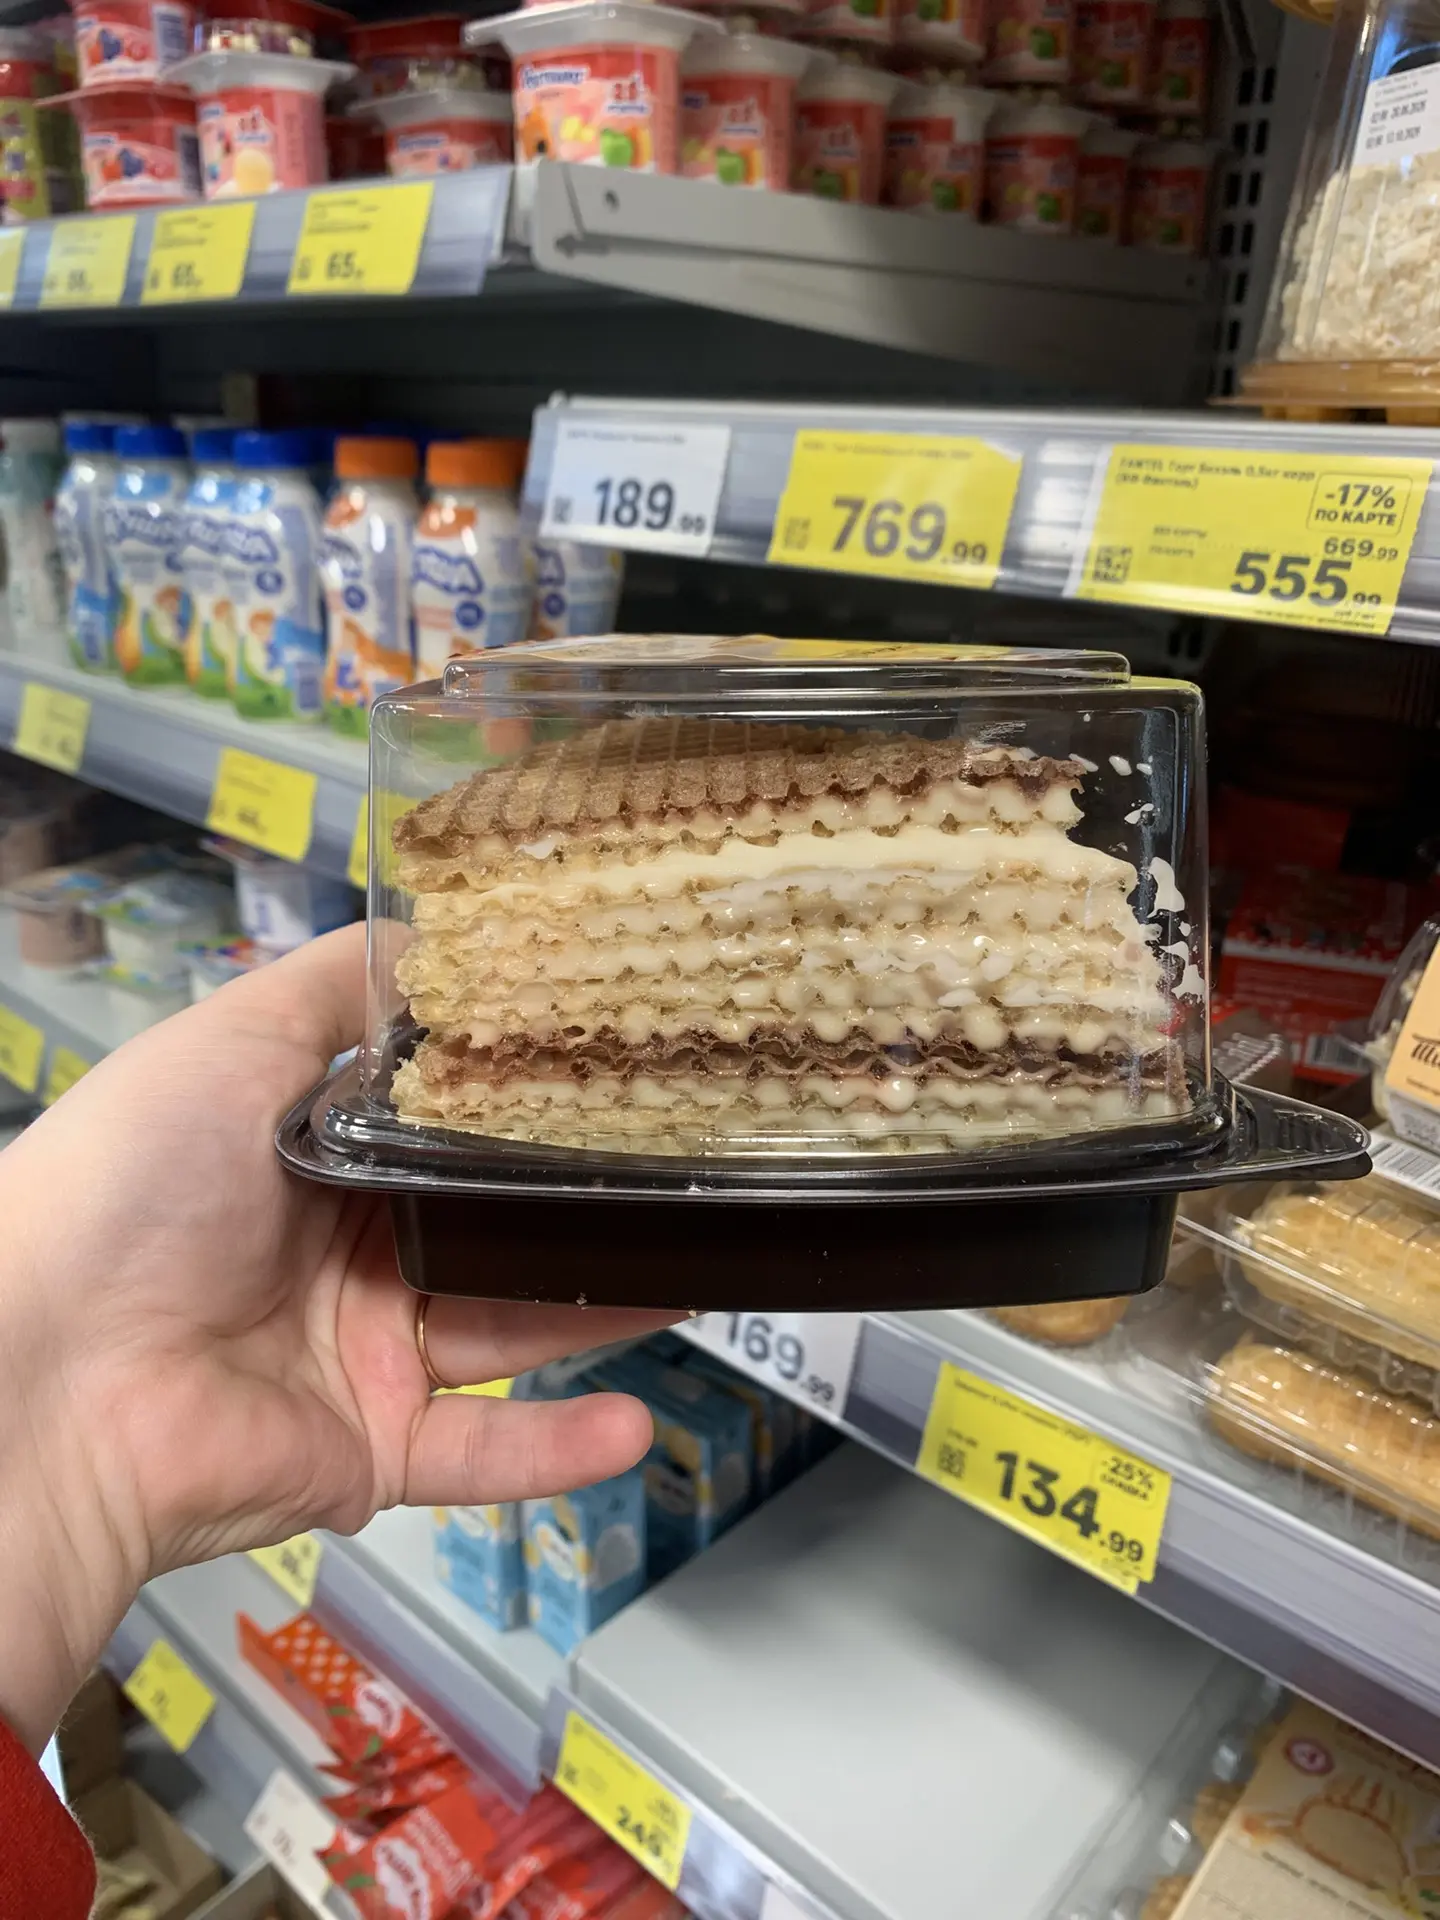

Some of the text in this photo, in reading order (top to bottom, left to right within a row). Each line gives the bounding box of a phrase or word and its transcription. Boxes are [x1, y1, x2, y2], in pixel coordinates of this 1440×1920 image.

[1325, 483, 1397, 510] -17%
[831, 495, 988, 566] 769.99
[1314, 508, 1398, 527] ПО КАРТЕ
[1323, 536, 1399, 561] 669.99
[995, 1450, 1145, 1563] 134.99
